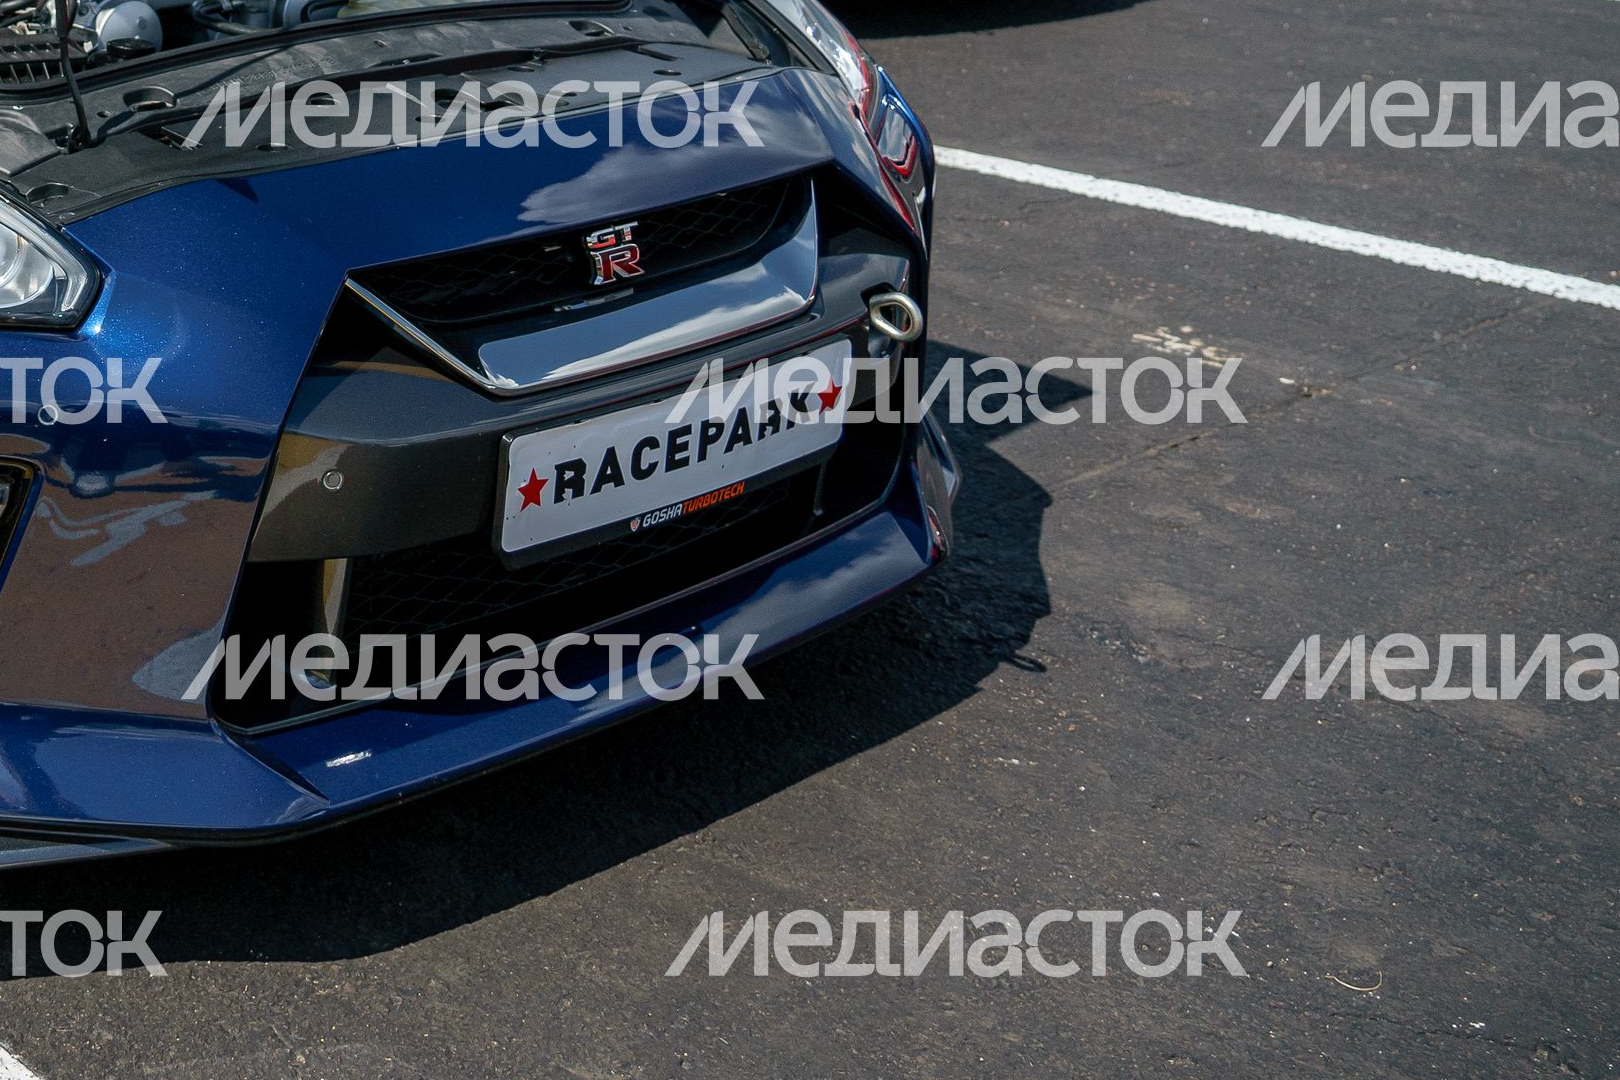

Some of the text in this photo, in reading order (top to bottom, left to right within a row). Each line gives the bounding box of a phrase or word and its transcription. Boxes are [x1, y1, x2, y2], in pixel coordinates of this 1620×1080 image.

[586, 221, 639, 249] GT
[589, 243, 646, 286] R
[553, 382, 812, 505] RACEPARK
[642, 481, 746, 529] GOSHATURBOTECH
